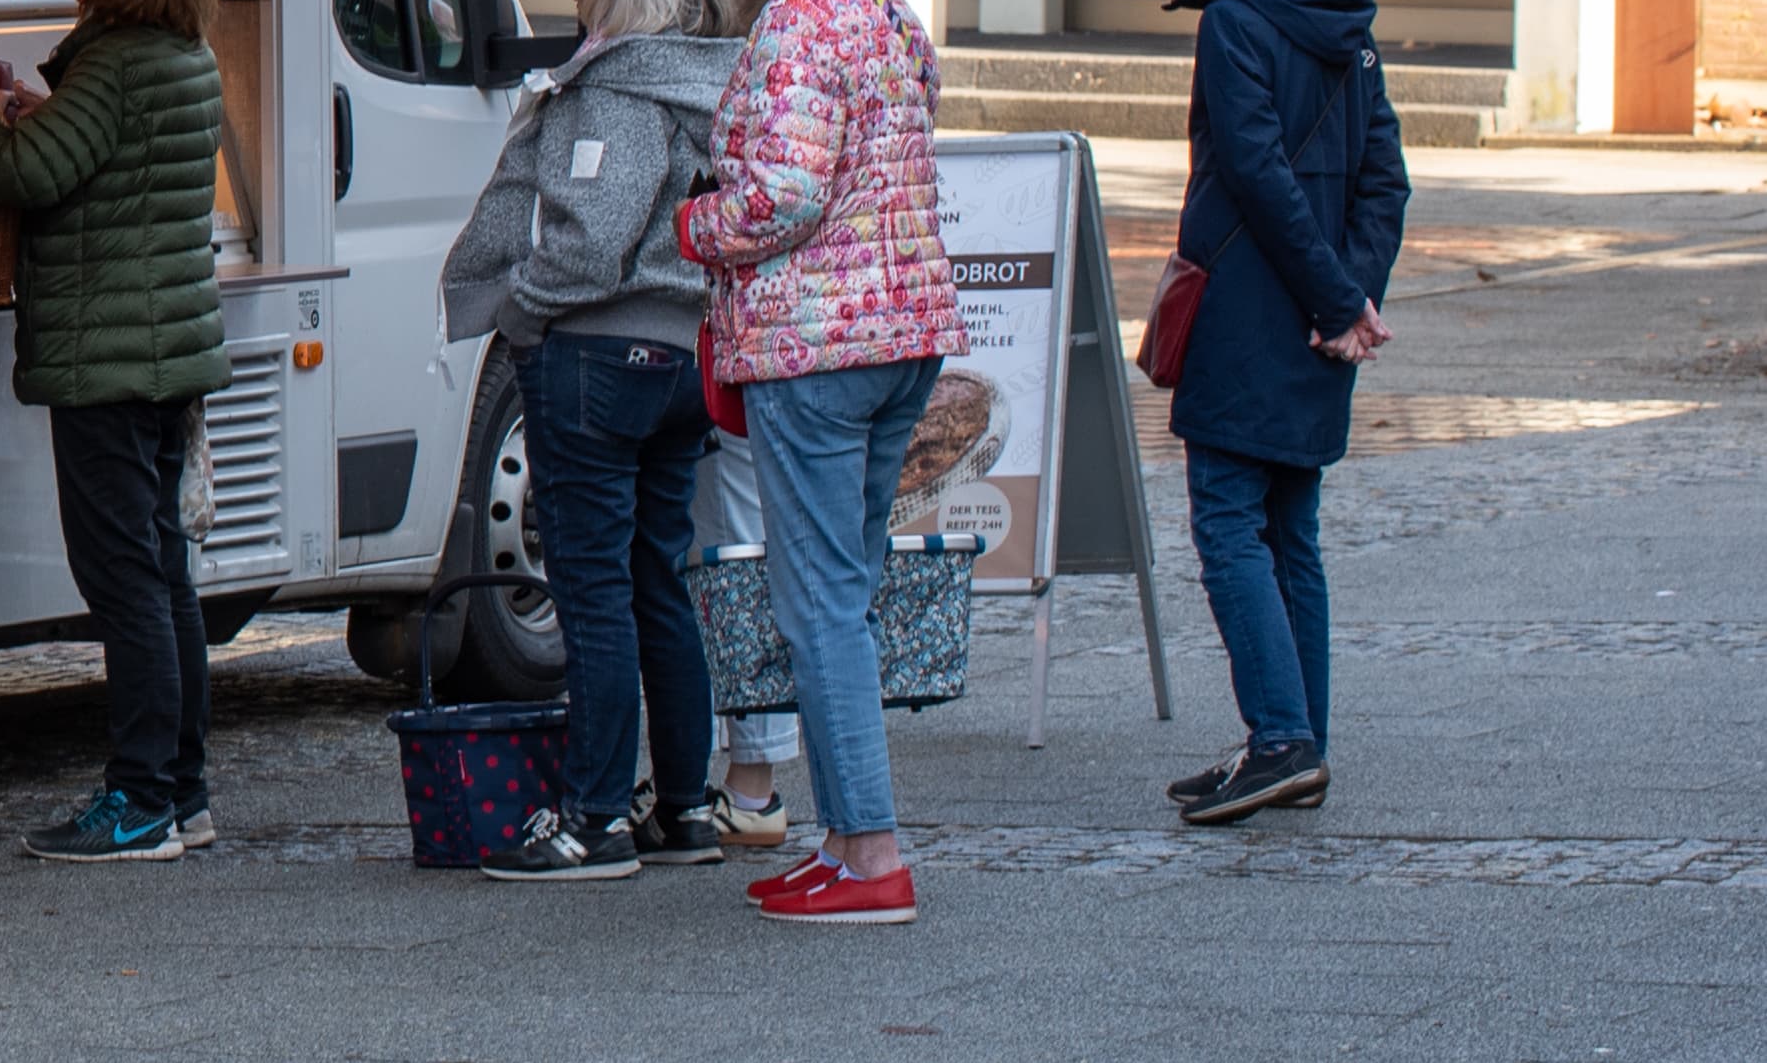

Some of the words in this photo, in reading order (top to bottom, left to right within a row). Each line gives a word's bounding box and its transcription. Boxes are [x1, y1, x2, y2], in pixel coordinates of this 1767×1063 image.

[949, 505, 971, 515] DER
[975, 505, 1001, 515] TEIG
[946, 520, 978, 530] REIFT
[981, 519, 1003, 530] 24H
